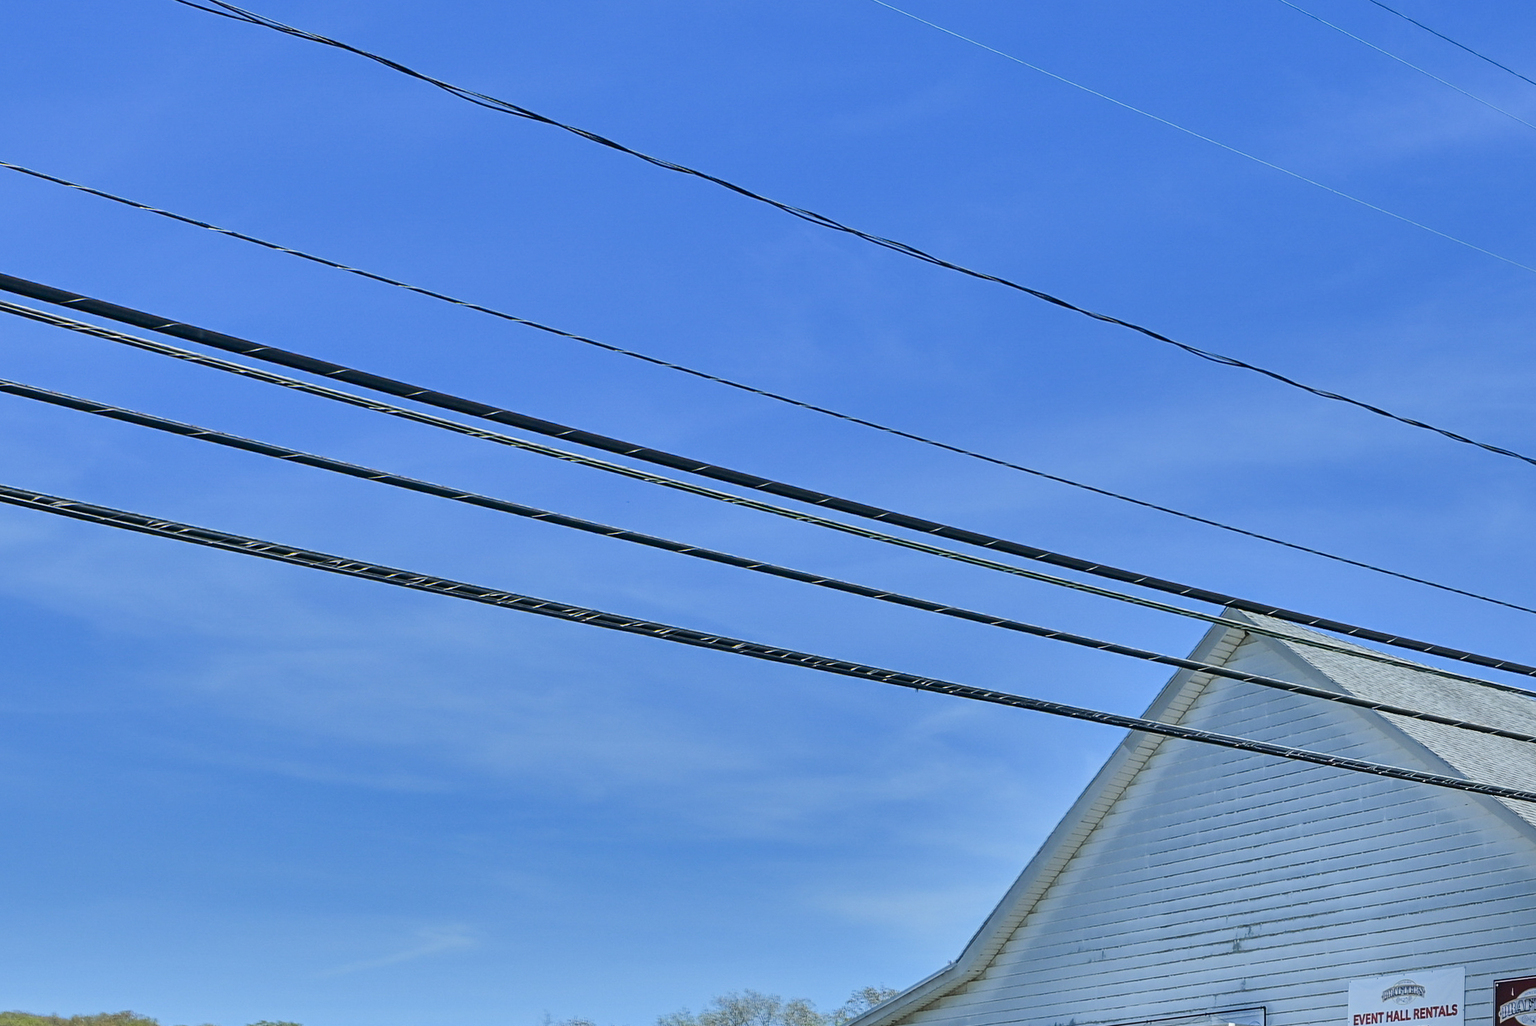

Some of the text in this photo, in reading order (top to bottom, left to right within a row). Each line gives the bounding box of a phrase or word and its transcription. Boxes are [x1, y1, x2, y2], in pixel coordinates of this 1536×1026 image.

[1353, 1003, 1458, 1026] EVENT HALL RENTALS
